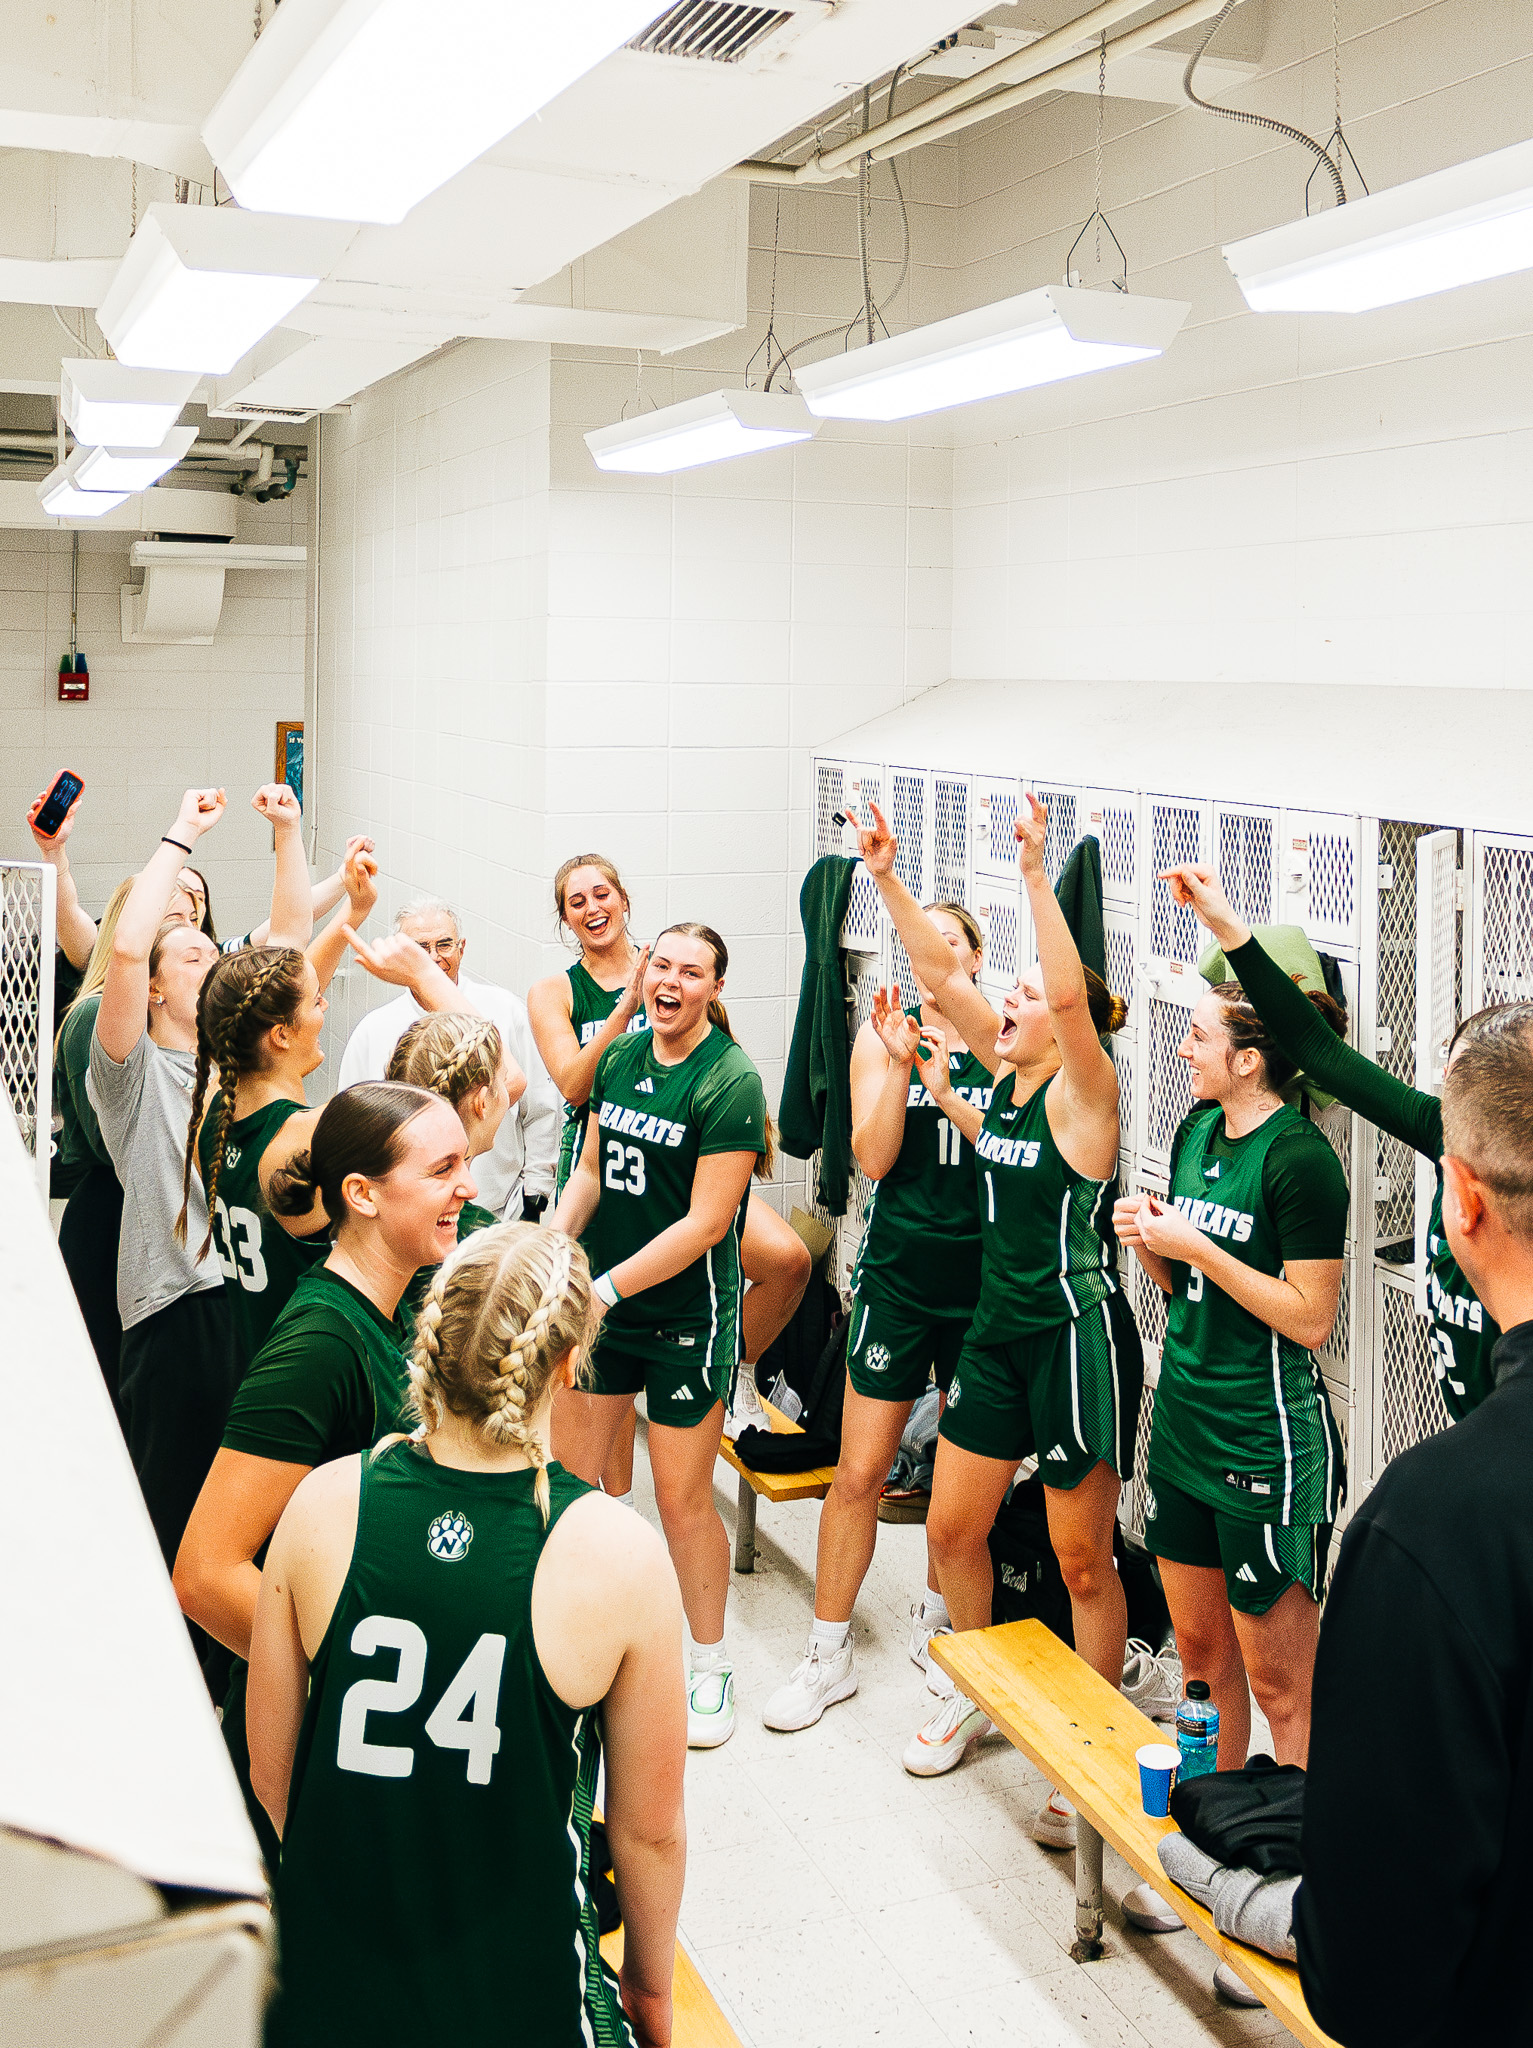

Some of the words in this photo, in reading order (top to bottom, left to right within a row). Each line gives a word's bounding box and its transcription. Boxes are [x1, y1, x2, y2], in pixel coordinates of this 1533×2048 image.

[938, 1118, 960, 1165] 11
[606, 1140, 646, 1195] 23
[985, 1171, 994, 1222] 1
[436, 1536, 458, 1554] N
[337, 1615, 506, 1785] 24
